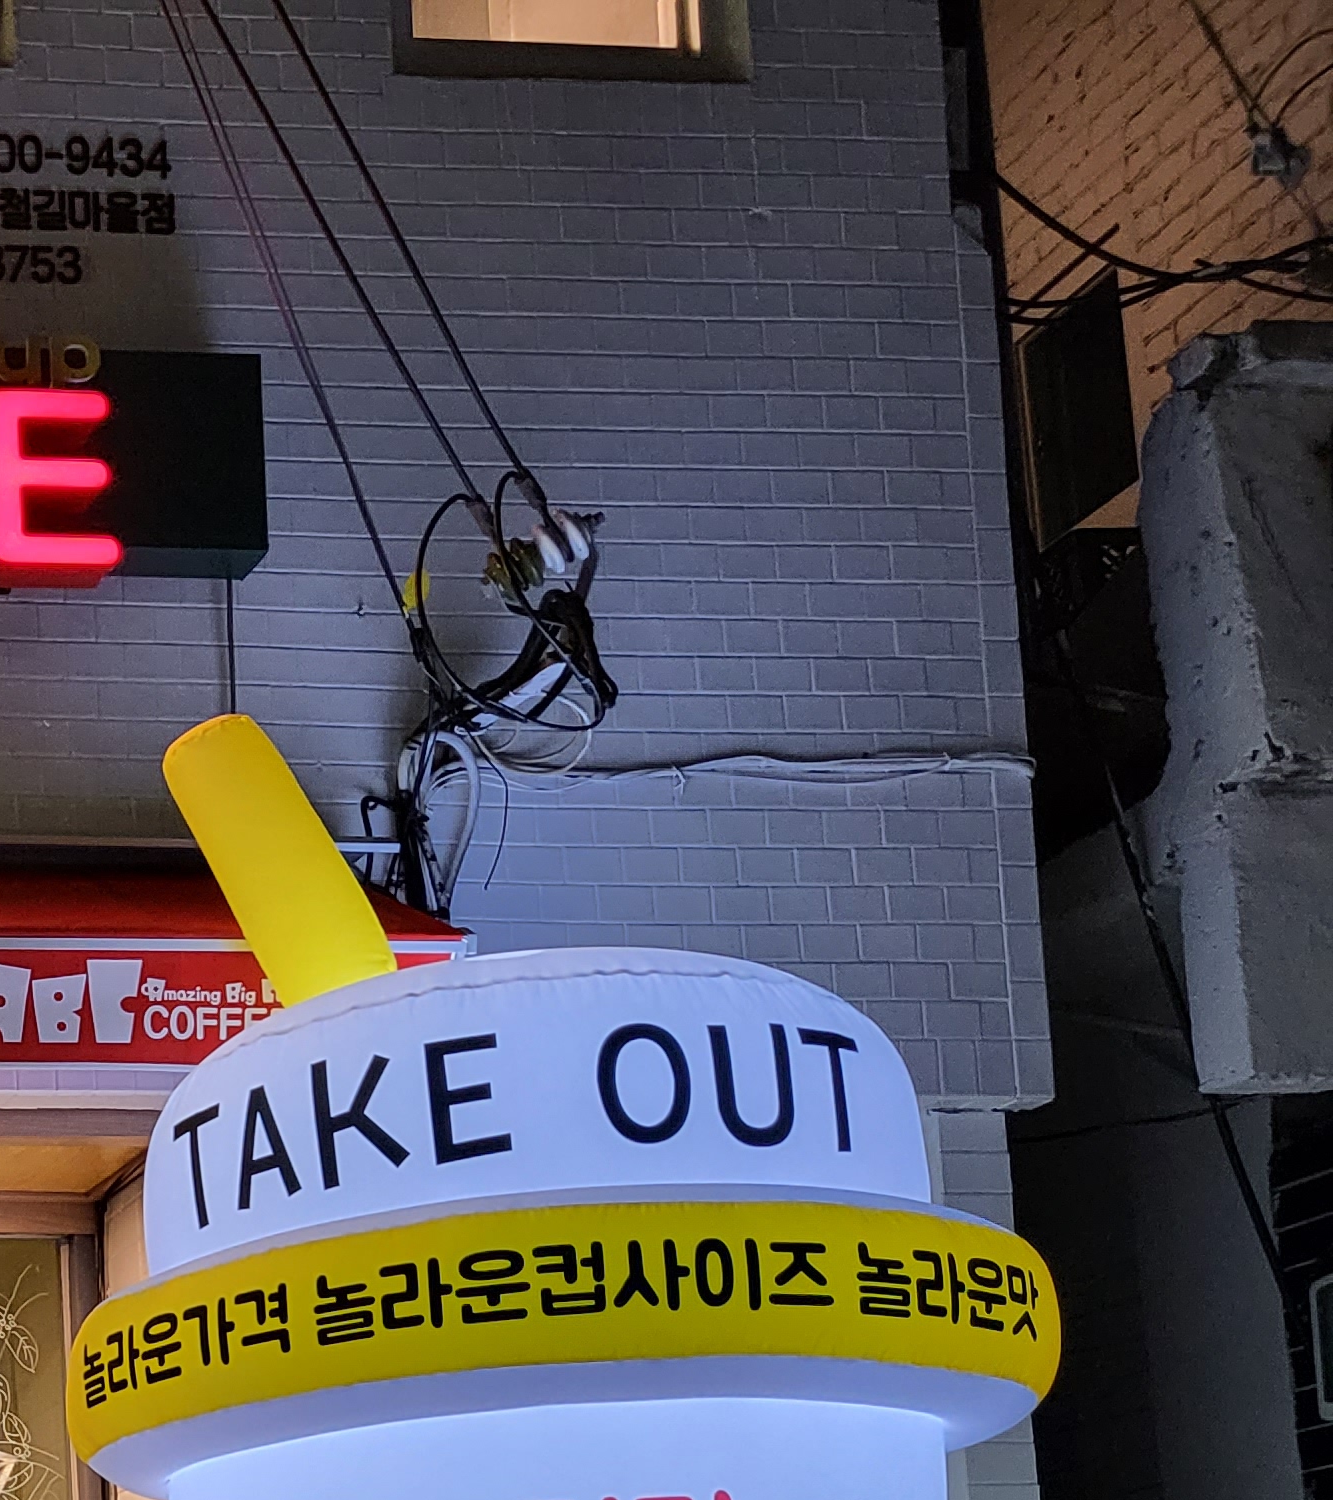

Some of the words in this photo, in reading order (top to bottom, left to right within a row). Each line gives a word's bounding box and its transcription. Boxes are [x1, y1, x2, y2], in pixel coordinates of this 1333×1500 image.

[172, 1033, 513, 1230] TAKE
[596, 1022, 859, 1155] OUT
[81, 1283, 292, 1408] 놀라운가격
[314, 1237, 835, 1346] 놀라운컵사이즈
[855, 1241, 1039, 1342] 놀라운맛
